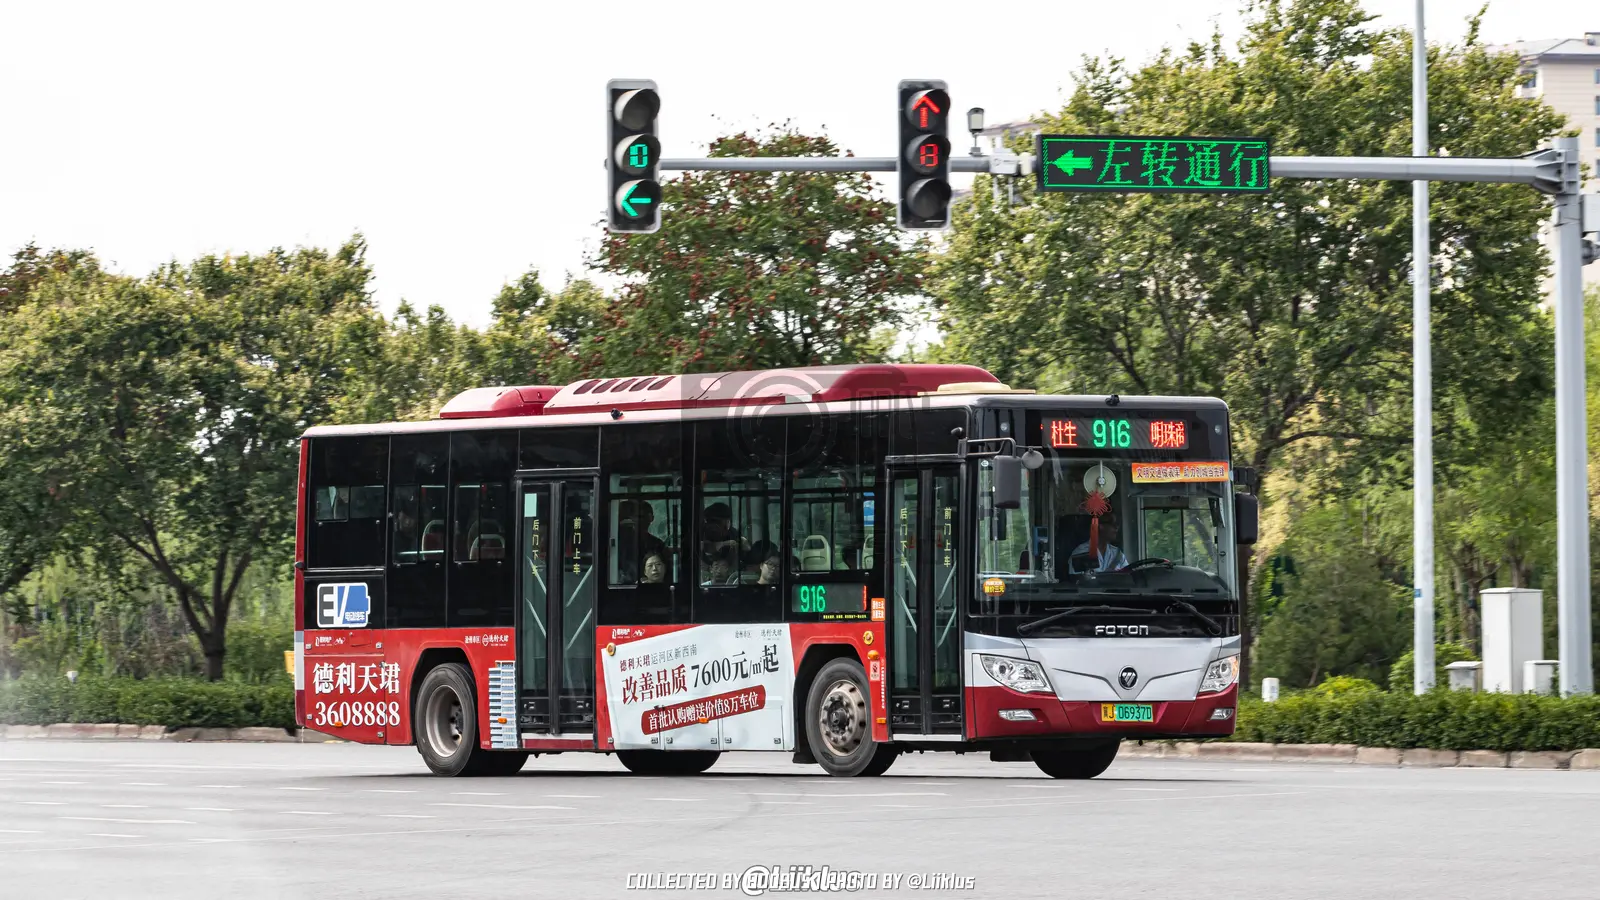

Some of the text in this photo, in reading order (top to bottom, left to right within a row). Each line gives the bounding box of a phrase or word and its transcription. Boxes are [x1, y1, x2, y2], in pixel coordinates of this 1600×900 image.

[1097, 140, 1266, 190] 左转通行
[1051, 420, 1078, 447] 杜生
[1092, 419, 1131, 448] 916
[531, 519, 540, 576] 后门下车
[573, 516, 582, 575] 前门上车
[900, 507, 908, 569] 后门下车
[943, 506, 952, 568] 前门上车
[319, 585, 351, 625] EV
[800, 585, 826, 612] 916
[1095, 624, 1149, 636] FOTON
[312, 661, 400, 695] 德利天珺
[622, 663, 688, 705] 改善品质
[314, 700, 400, 727] 3608888
[648, 691, 759, 731] 首批认购赠送价值8万车位
